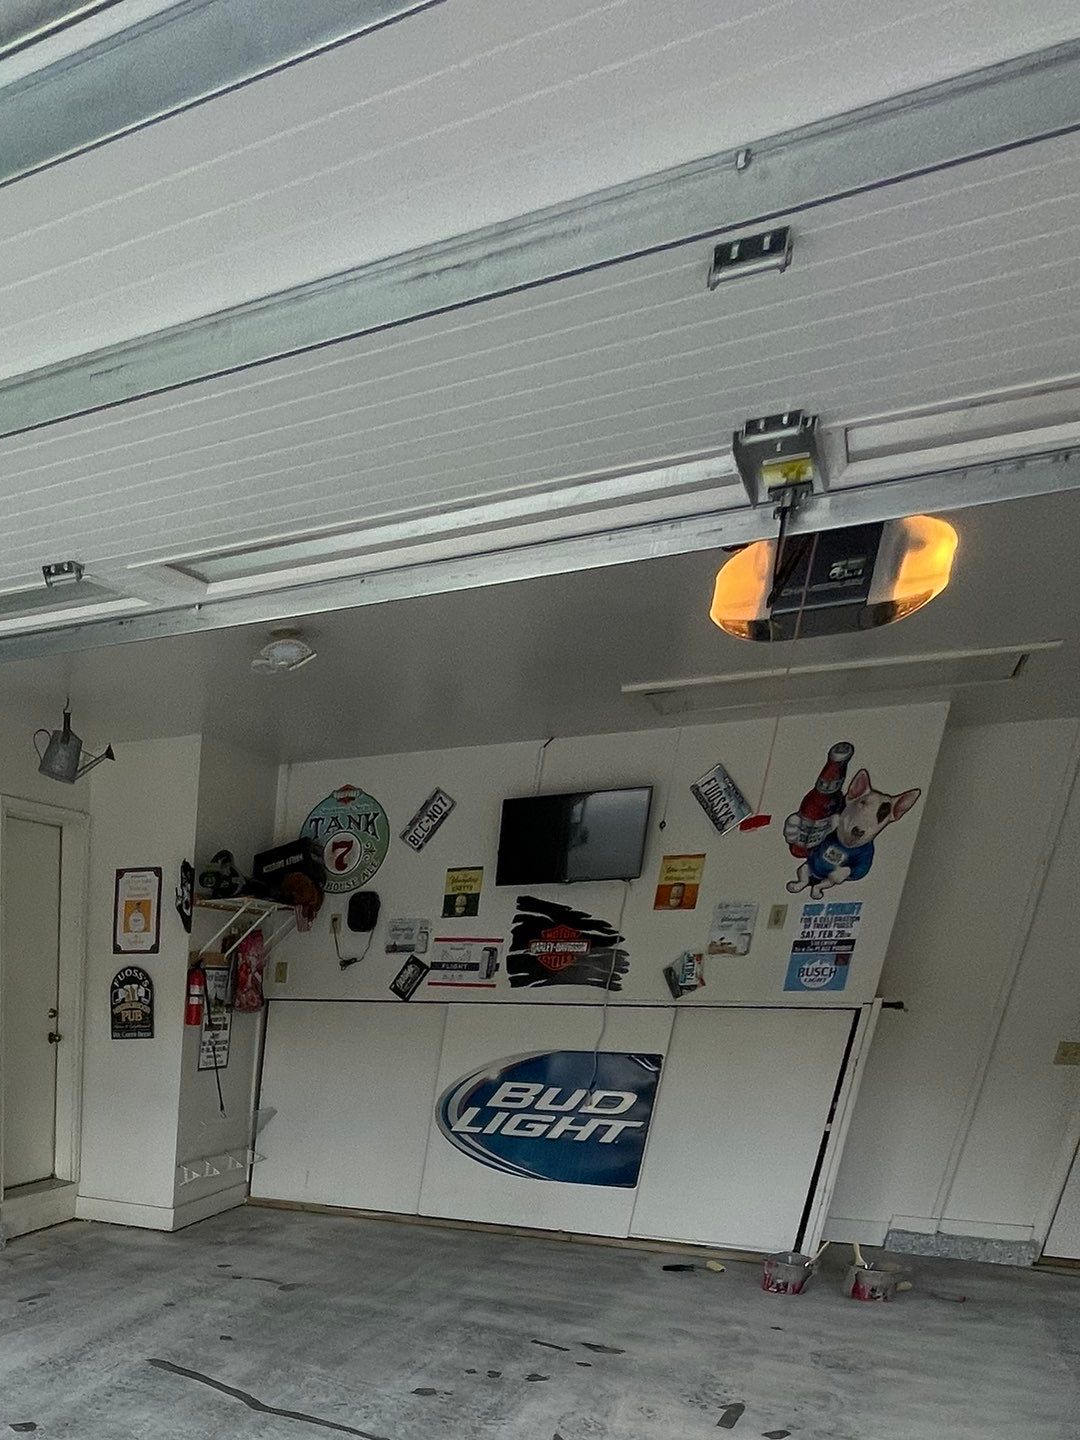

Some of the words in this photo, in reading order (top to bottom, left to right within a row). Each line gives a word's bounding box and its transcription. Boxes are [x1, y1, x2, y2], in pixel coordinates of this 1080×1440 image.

[309, 812, 380, 841] TANK
[331, 840, 353, 871] 7
[797, 966, 838, 978] BUSCH
[121, 1010, 143, 1022] PUB
[486, 1081, 639, 1116] BUD
[451, 1106, 646, 1144] LIGHT
